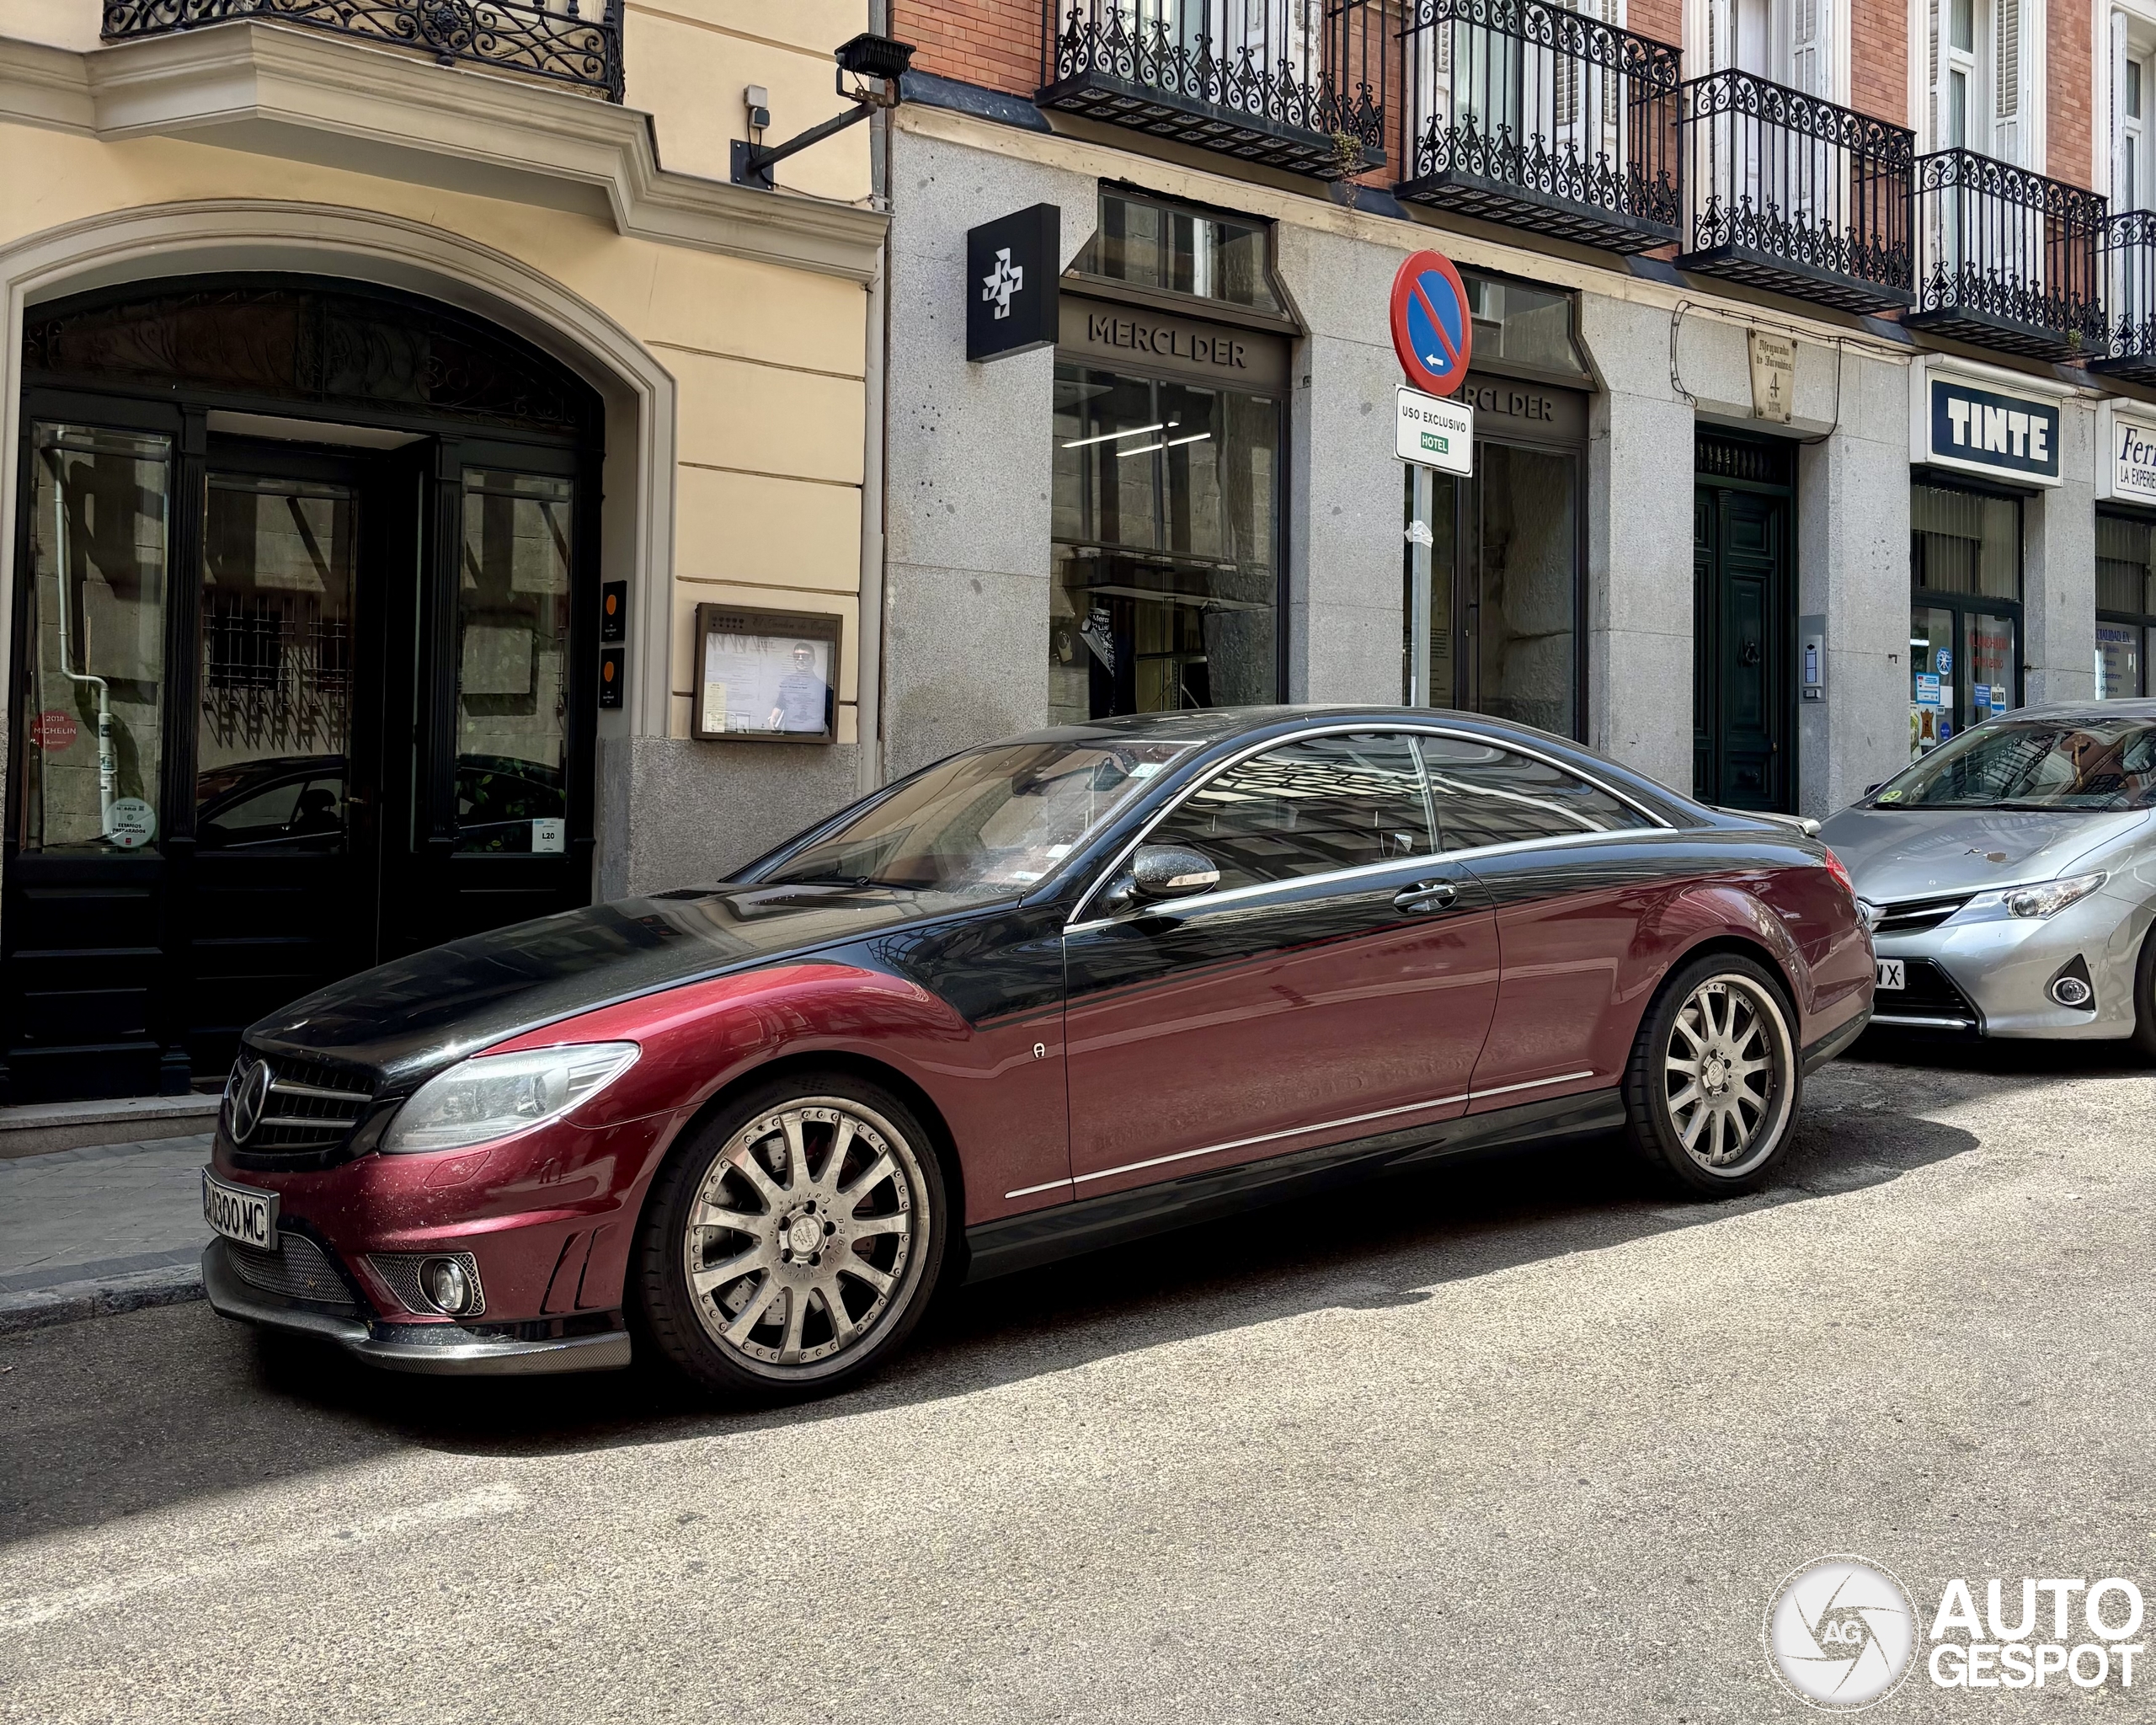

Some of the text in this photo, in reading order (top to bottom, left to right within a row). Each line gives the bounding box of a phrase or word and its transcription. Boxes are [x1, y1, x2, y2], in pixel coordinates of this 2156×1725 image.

[1769, 372, 1780, 398] 4
[1402, 405, 1466, 432] USO EXCLUSIVO
[1947, 397, 2049, 462] TINTE
[1422, 435, 1448, 452] HOTEL
[2119, 426, 2156, 467] Fer
[2121, 465, 2130, 483] LA
